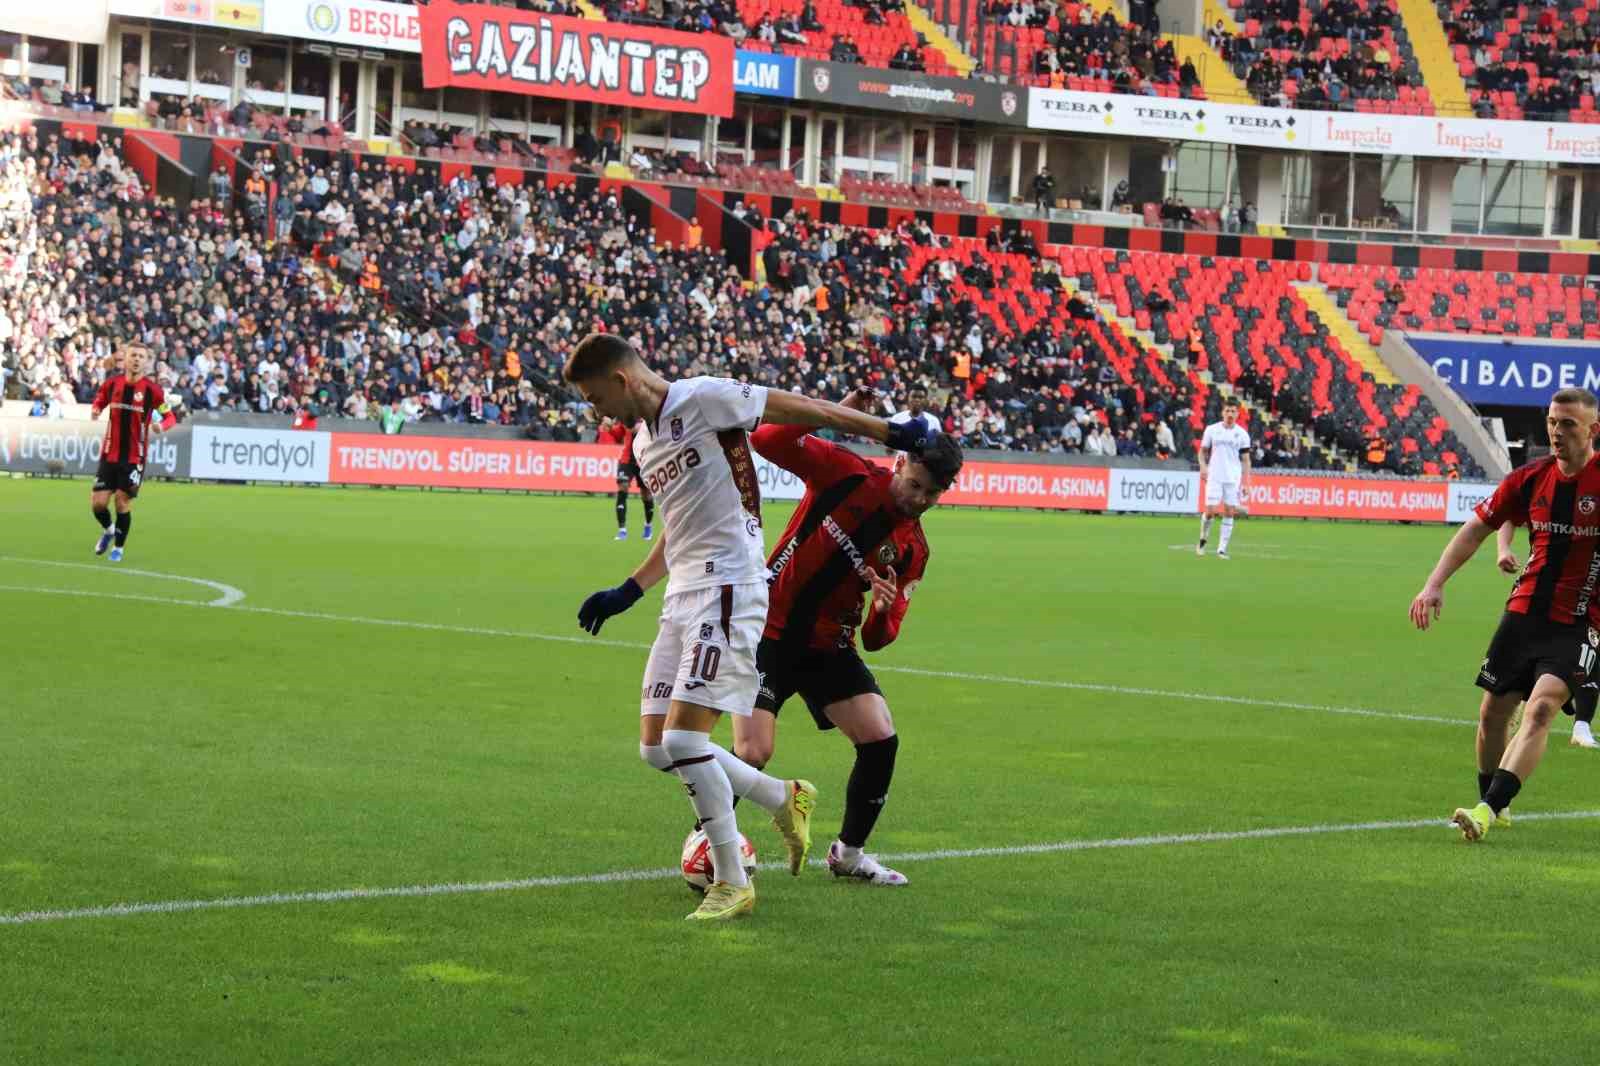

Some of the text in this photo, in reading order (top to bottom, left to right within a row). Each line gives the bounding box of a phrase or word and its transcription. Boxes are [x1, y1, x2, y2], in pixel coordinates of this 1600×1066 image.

[447, 17, 709, 101] GAZİANTEP
[1041, 99, 1101, 114] TEBA
[1134, 107, 1193, 121] TEBA
[1225, 115, 1283, 128] TEBA
[210, 436, 315, 472] trendyol
[338, 447, 443, 472] TRENDYOL
[448, 447, 513, 475] SÜPER
[515, 449, 545, 475] LİG
[959, 470, 984, 493] LİG
[988, 474, 1047, 495] FUTBOL
[1050, 477, 1106, 500] AŞKINA
[1120, 477, 1189, 510] trendyol
[1278, 483, 1321, 505] SÜPER
[1324, 485, 1345, 505] LİG
[1347, 488, 1397, 508] FUTBOL
[1399, 491, 1446, 512] AŞKINA
[690, 642, 721, 682] 10
[653, 682, 673, 698] Go
